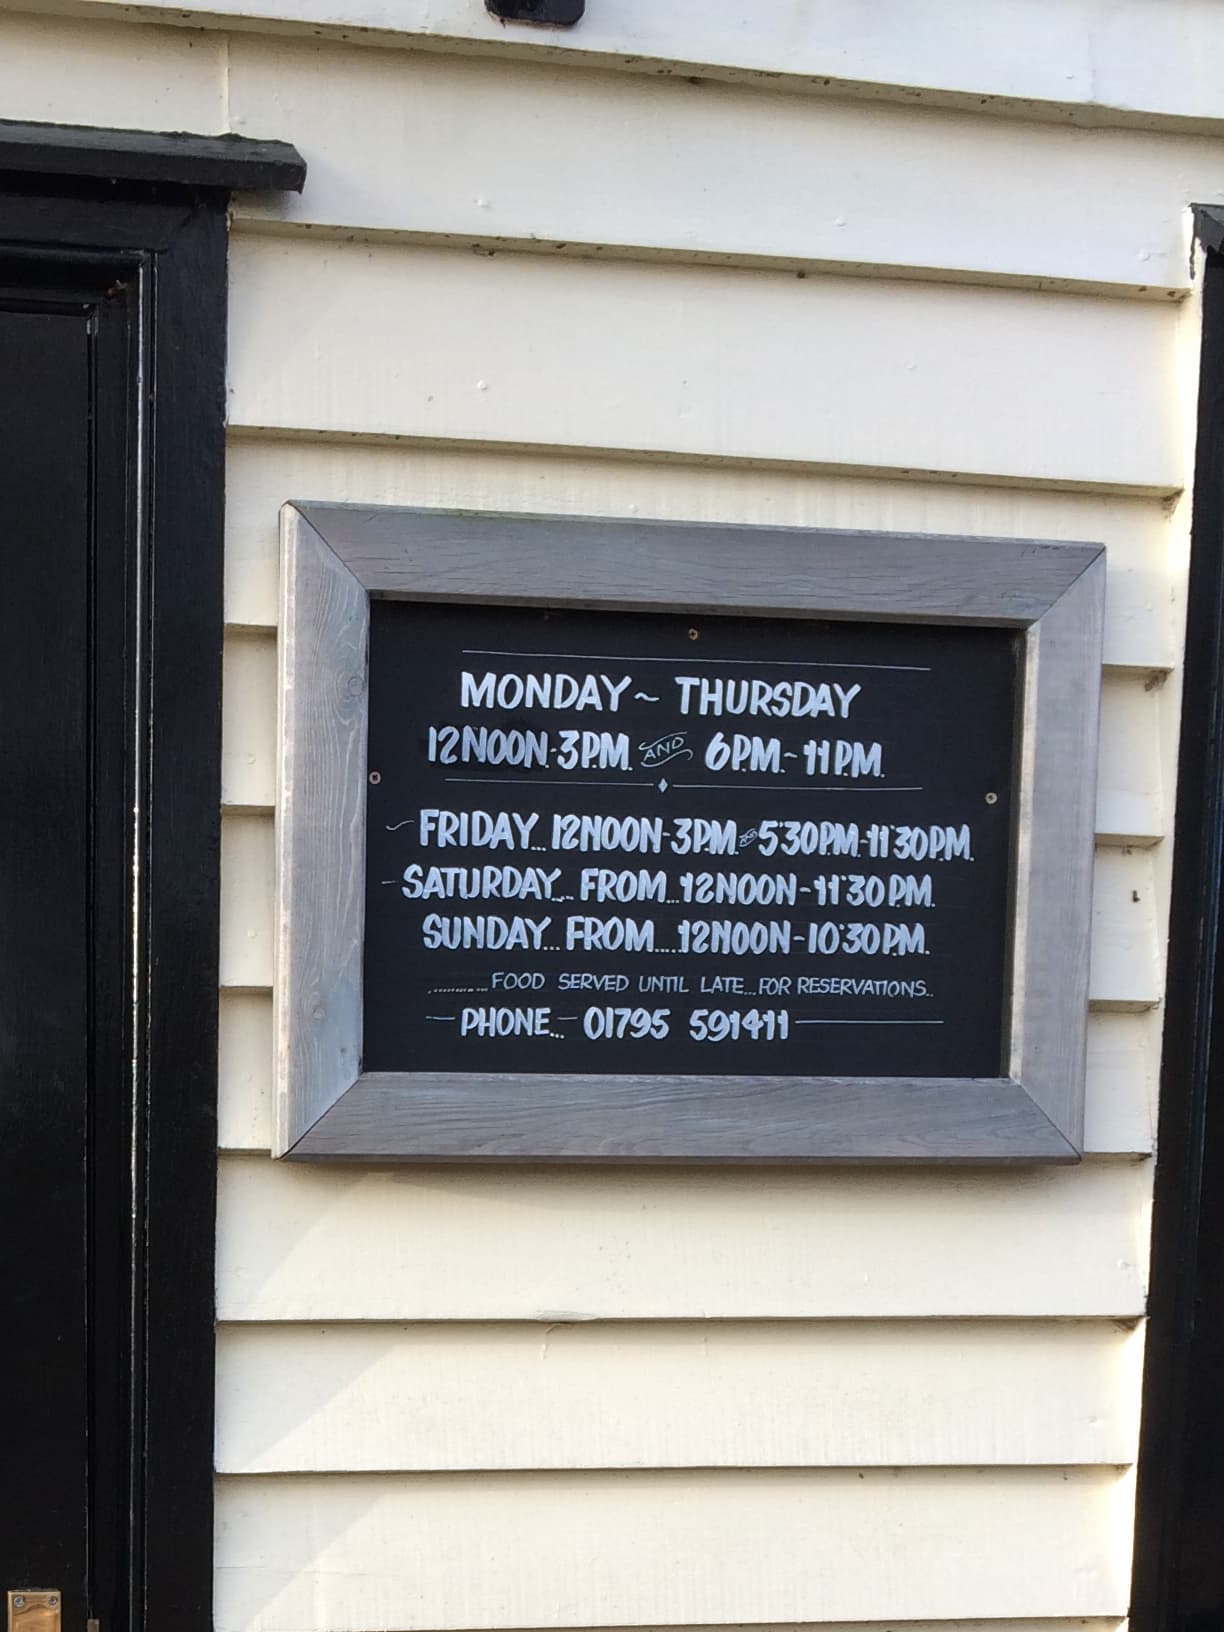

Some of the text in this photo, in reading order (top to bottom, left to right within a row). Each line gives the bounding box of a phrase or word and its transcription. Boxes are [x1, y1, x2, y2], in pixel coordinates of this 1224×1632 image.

[674, 676, 861, 718] THURSDAY
[491, 971, 546, 990] FOOD
[557, 973, 630, 992] SERVED
[639, 975, 689, 993] UNTIL
[759, 978, 792, 996] FOR
[583, 1006, 671, 1040] 01795
[689, 1008, 789, 1042] 591411
